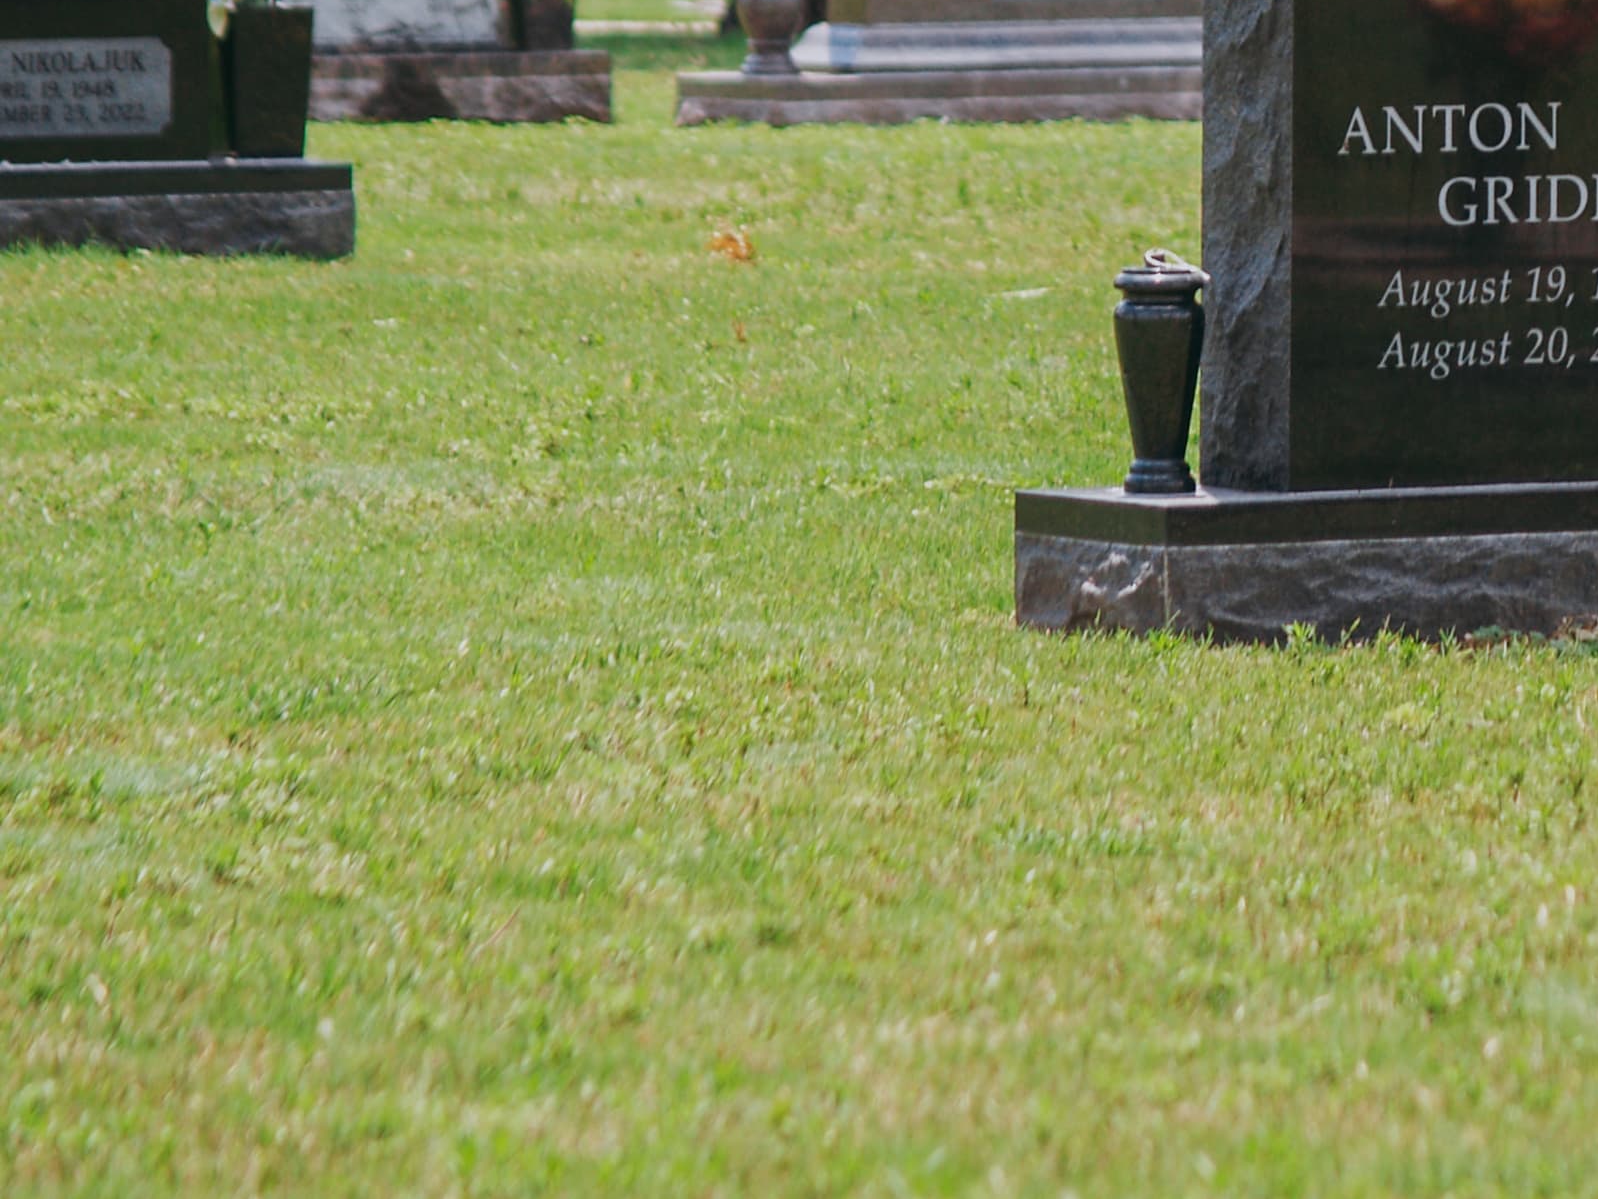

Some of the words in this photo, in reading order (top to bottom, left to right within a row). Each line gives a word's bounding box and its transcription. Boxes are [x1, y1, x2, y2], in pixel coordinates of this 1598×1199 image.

[12, 51, 146, 74] NIKOLAJUK
[1337, 101, 1562, 156] ANTON
[1377, 269, 1512, 319] August
[1526, 265, 1576, 308] 19,
[1376, 331, 1512, 380] August
[1523, 327, 1577, 370] 20,
